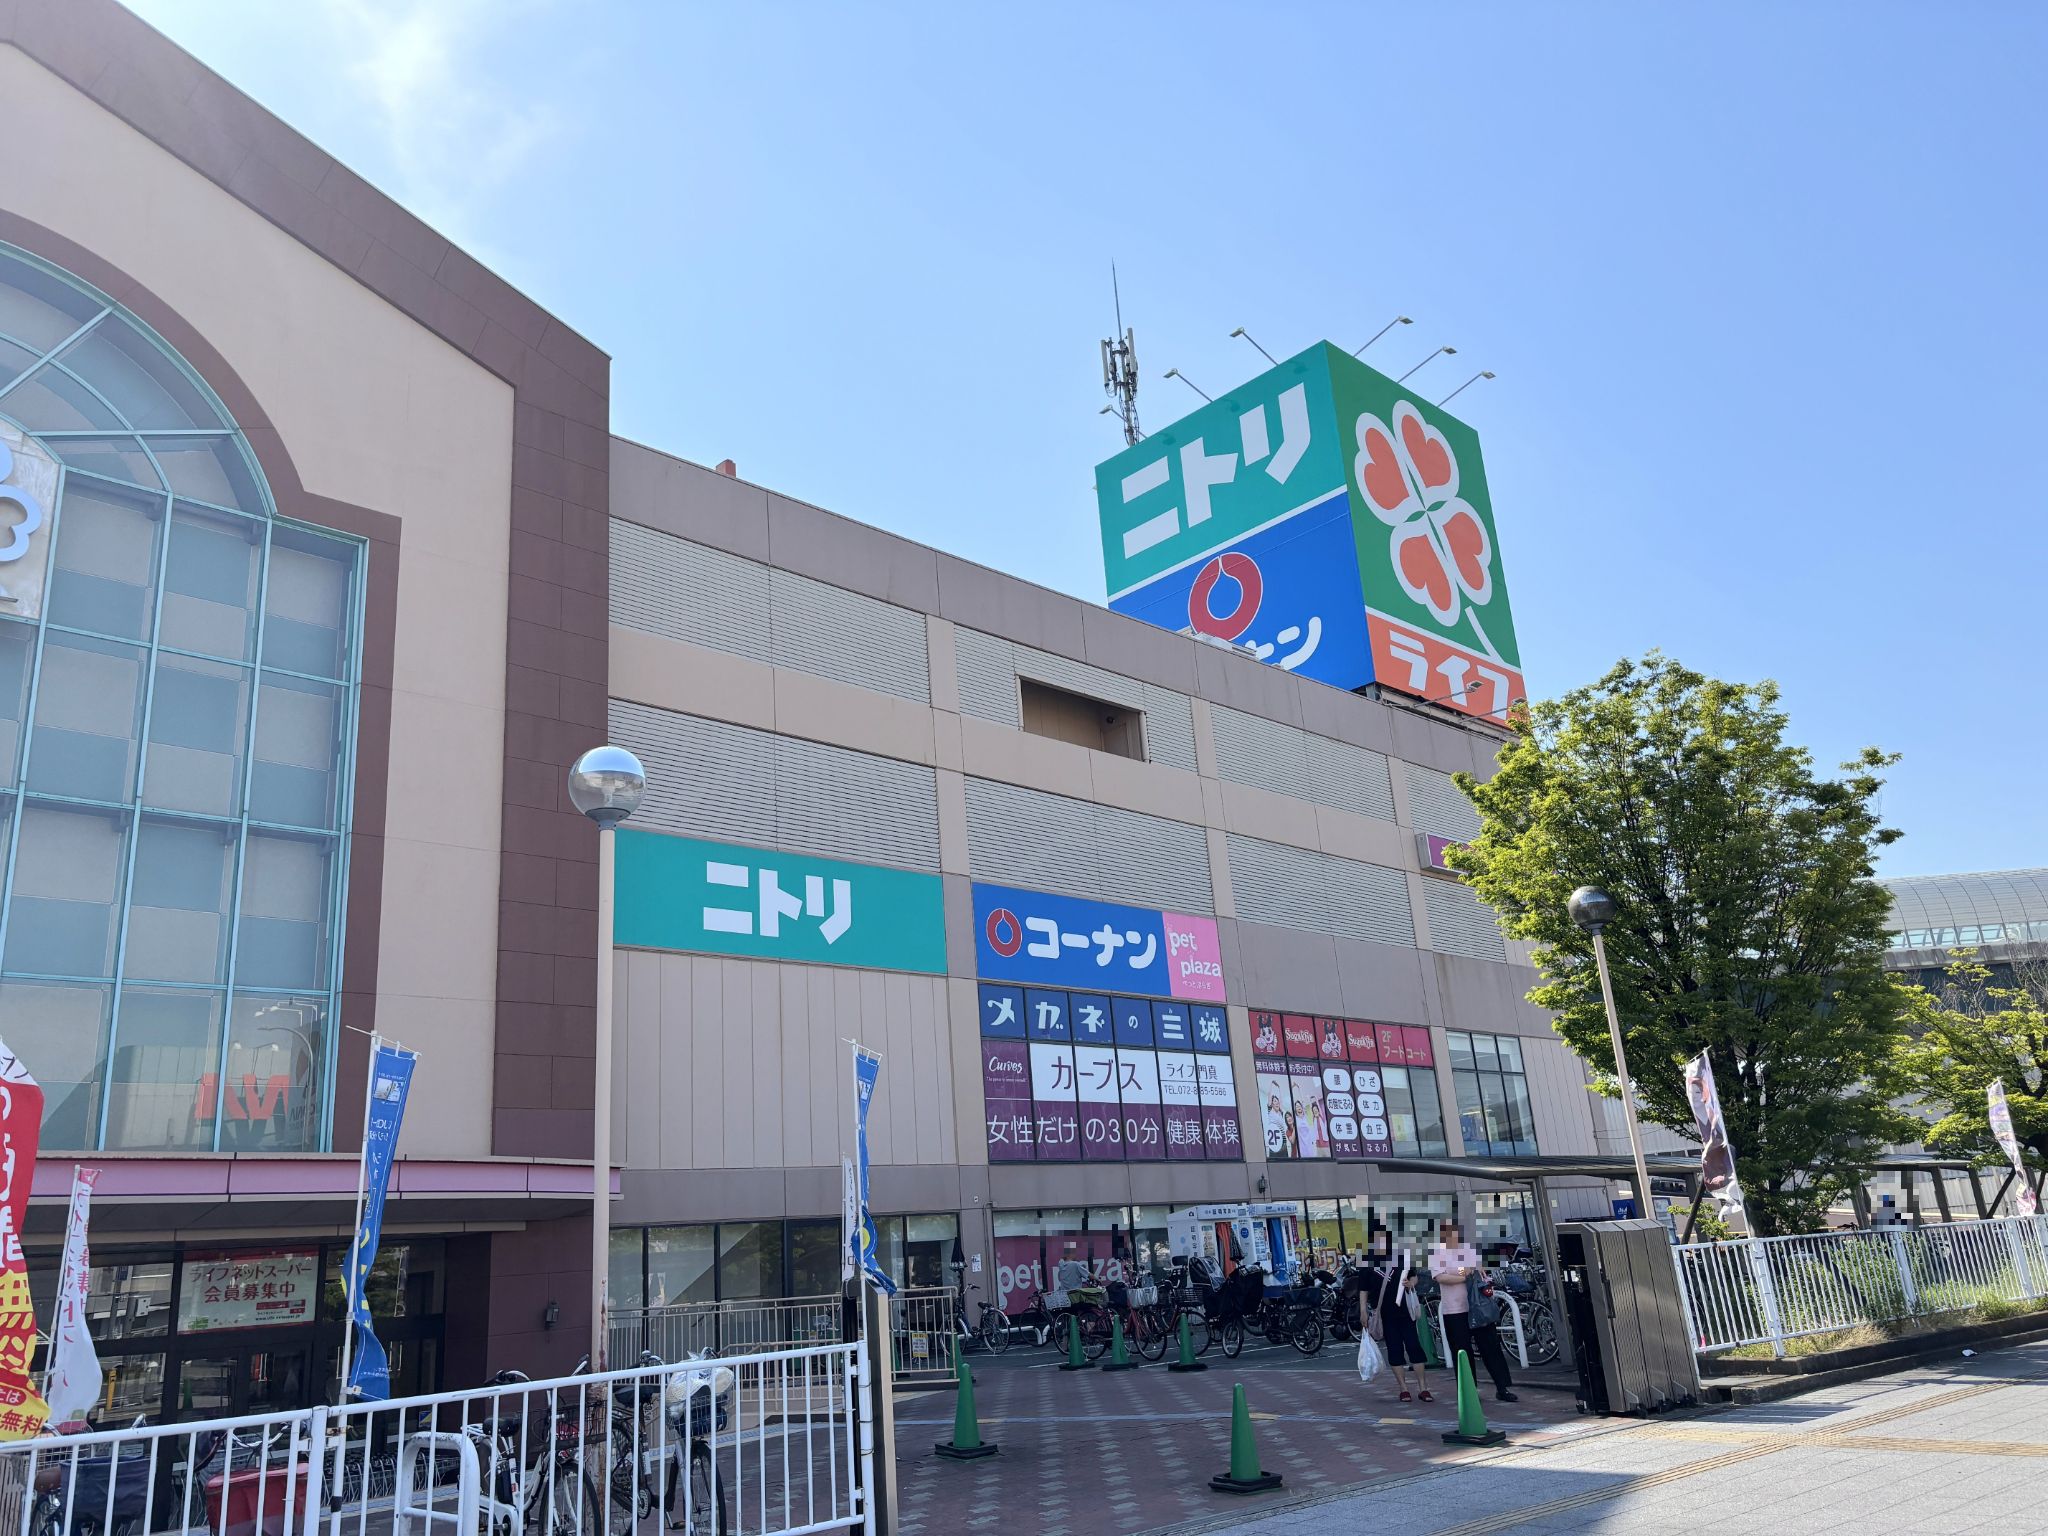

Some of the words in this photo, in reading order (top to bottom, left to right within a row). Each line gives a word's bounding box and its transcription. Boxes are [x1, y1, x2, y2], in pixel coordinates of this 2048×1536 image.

[1121, 382, 1311, 560] ニトリ
[1389, 629, 1510, 721] ライフ
[703, 860, 852, 945] ニトリ
[1025, 916, 1157, 970] コーナン
[1168, 931, 1198, 957] pet
[1180, 957, 1222, 978] plaza
[1382, 1030, 1392, 1042] 2F
[1384, 1045, 1427, 1061] フードコート
[988, 1056, 1023, 1074] Curves
[1050, 1055, 1143, 1091] カーブス
[1166, 1063, 1218, 1081] ライフ門真
[1359, 1076, 1376, 1088] ひざ
[1267, 1129, 1280, 1146] 2F
[1365, 1123, 1383, 1135] 血圧
[189, 1262, 313, 1283] ライフネットスーパー
[204, 1280, 296, 1304] 会員募集中
[996, 1259, 1043, 1311] pet
